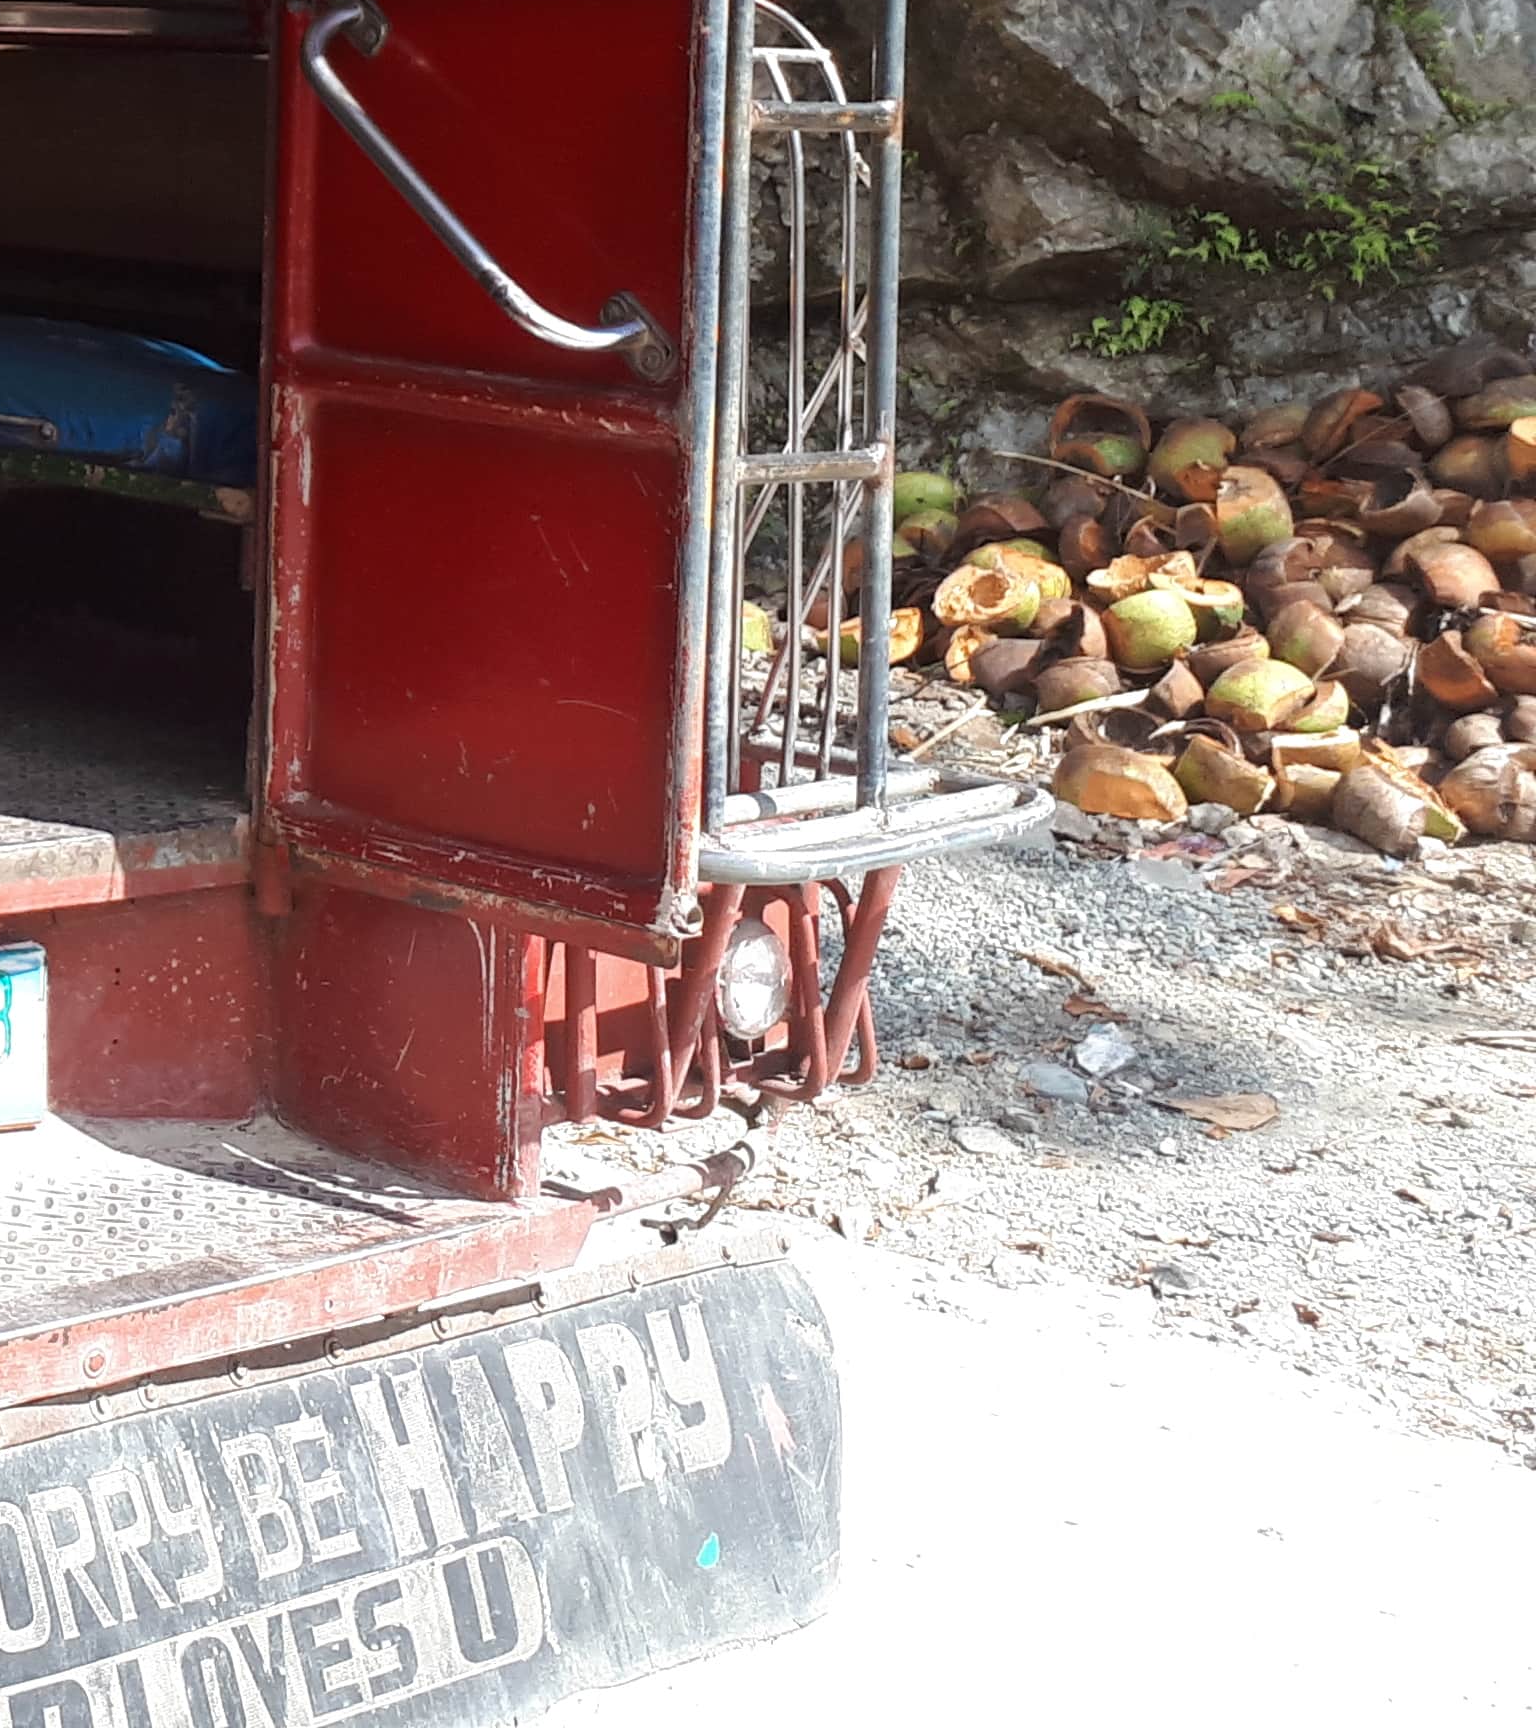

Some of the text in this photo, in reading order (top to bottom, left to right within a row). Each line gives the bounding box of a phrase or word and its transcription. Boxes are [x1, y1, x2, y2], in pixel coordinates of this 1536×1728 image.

[219, 1415, 364, 1581] BE
[352, 1301, 734, 1556] HAPPY
[439, 1544, 524, 1665] U
